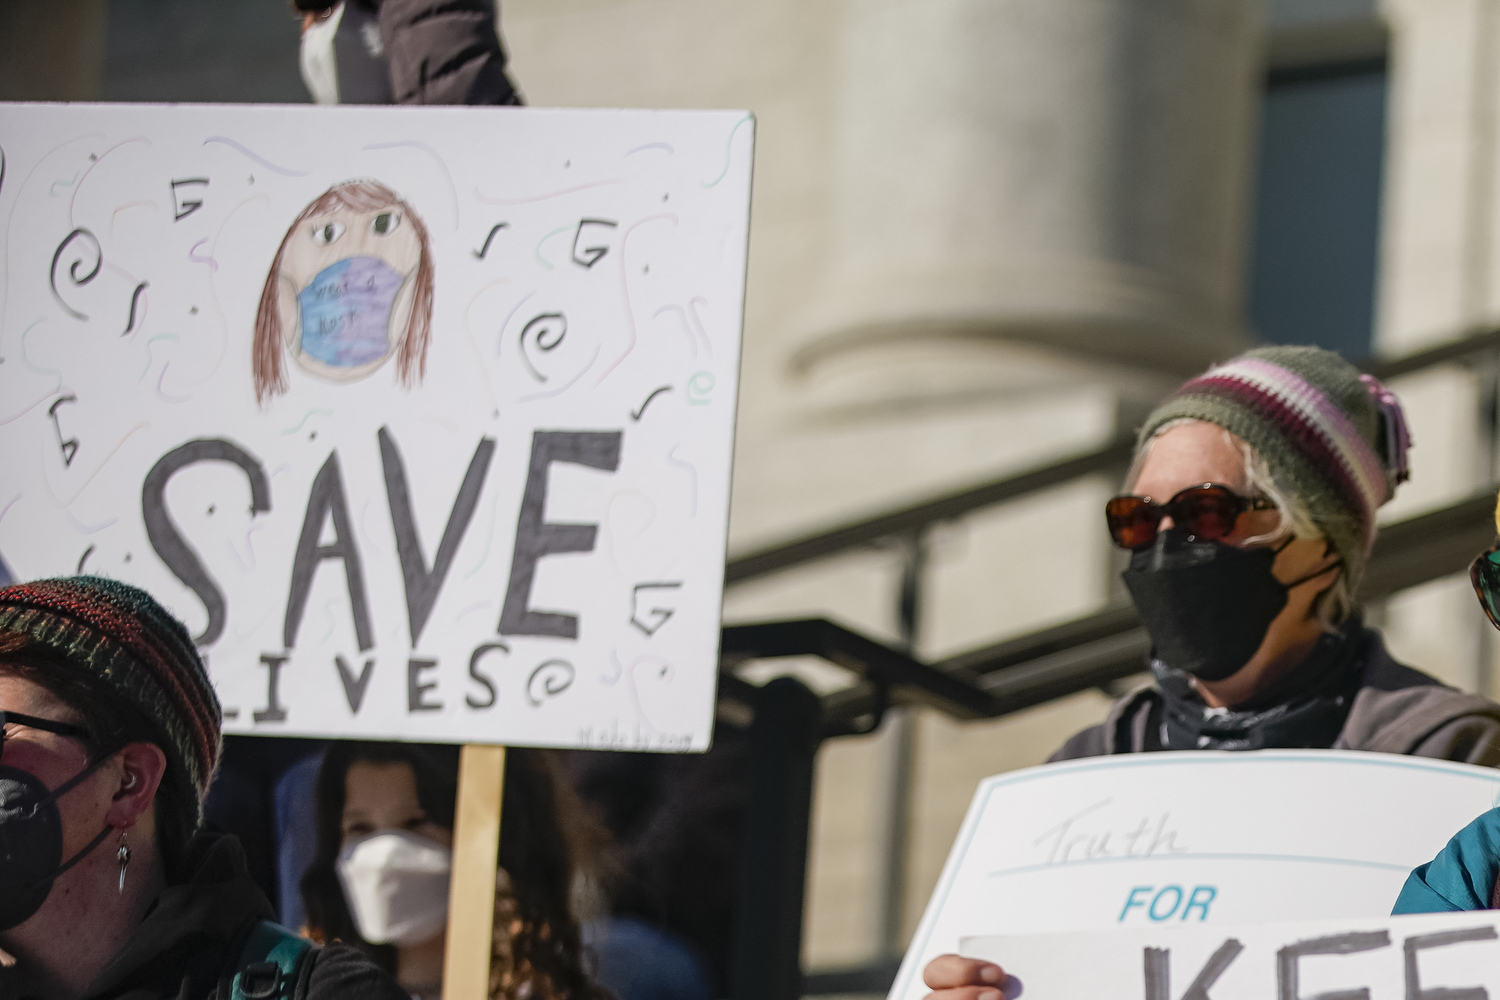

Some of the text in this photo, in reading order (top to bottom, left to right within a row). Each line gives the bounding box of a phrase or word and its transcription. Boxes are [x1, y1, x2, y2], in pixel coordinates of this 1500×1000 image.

[142, 424, 625, 652] SAVE
[206, 642, 512, 724] IVES
[1032, 797, 1189, 865] Truth
[1116, 884, 1219, 923] FOR
